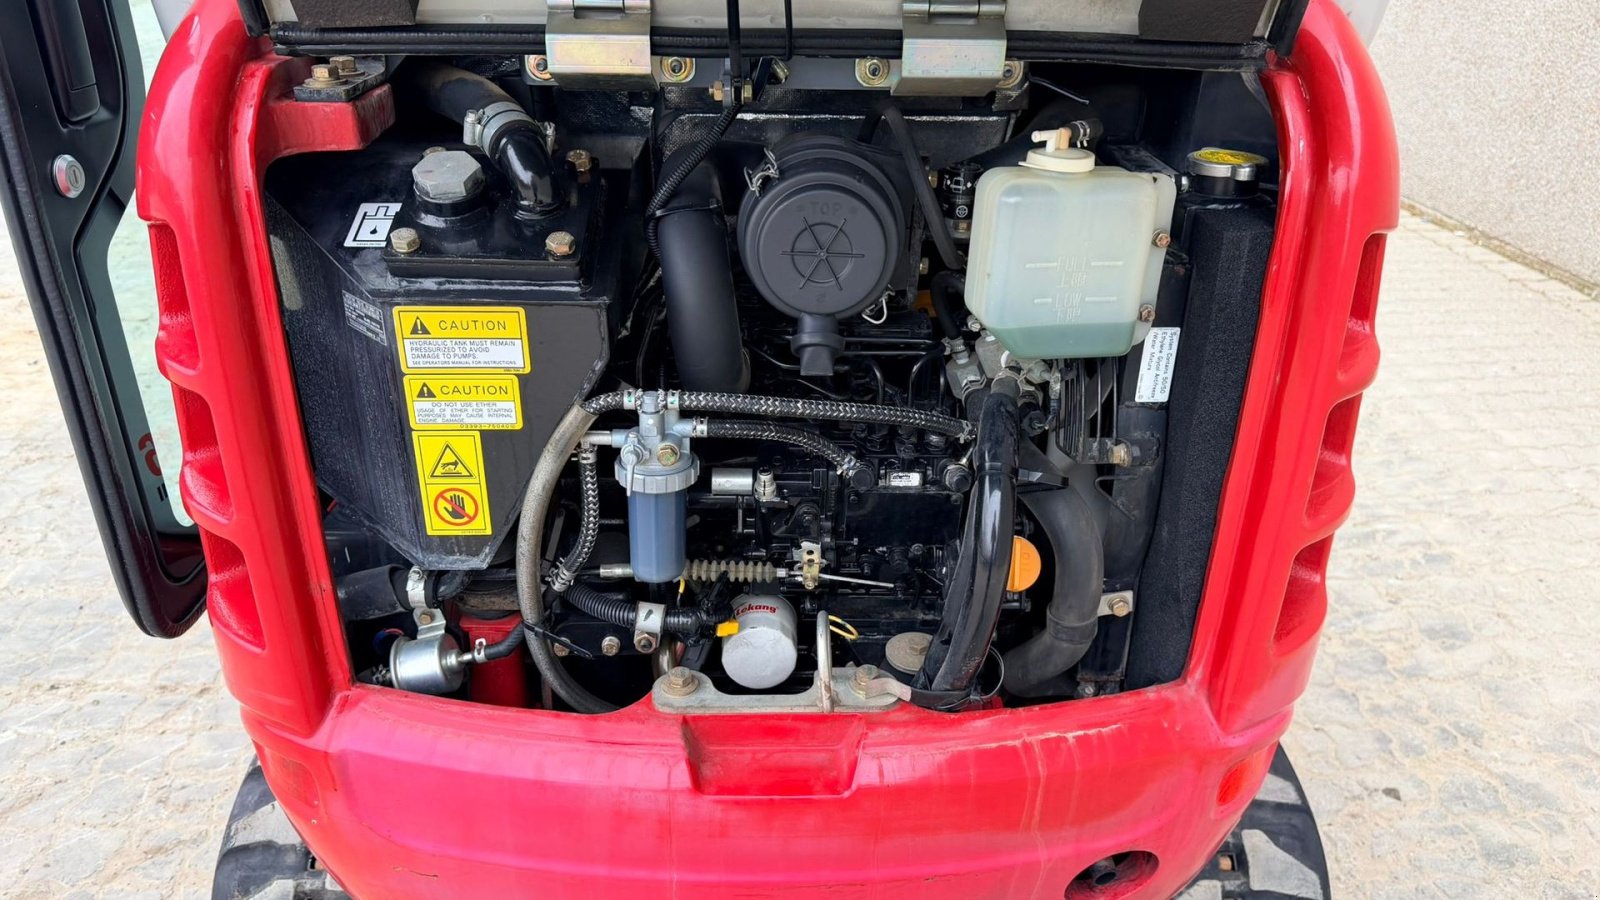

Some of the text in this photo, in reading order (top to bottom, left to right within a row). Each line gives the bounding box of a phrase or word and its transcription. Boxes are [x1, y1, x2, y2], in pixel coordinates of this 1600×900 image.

[810, 201, 842, 215] TOP
[1056, 256, 1087, 272] FULL
[1056, 293, 1082, 308] LOW
[438, 320, 507, 330] CAUTION
[1159, 332, 1168, 354] Ethylene
[1147, 352, 1156, 370] Mixture
[1160, 332, 1177, 394] System Contains 50/50
[440, 385, 508, 395] CAUTION
[1151, 373, 1160, 398] Antifreeze
